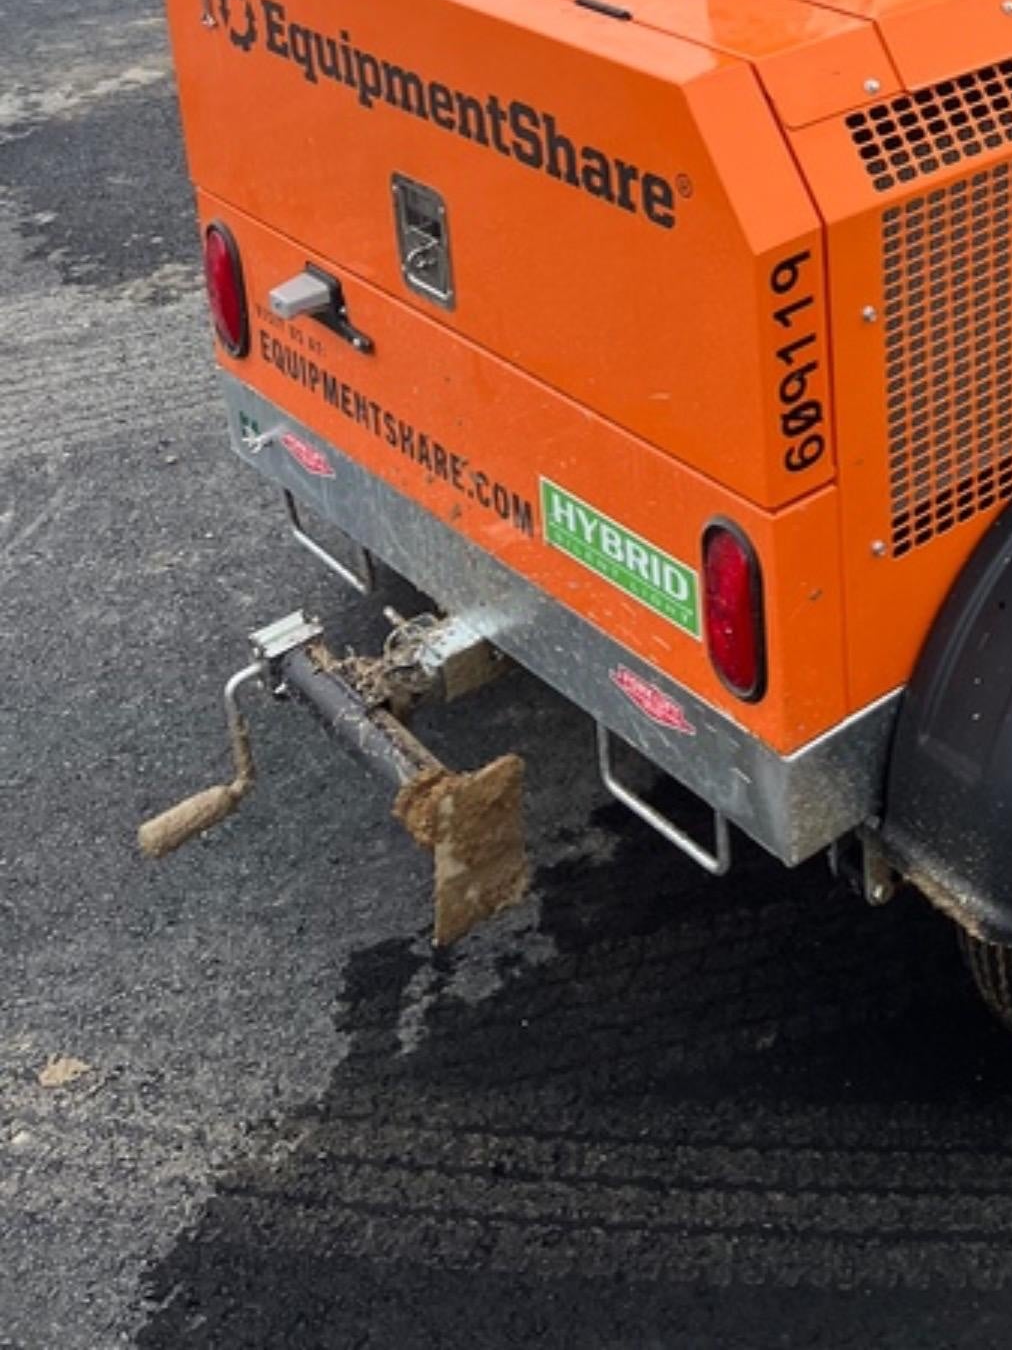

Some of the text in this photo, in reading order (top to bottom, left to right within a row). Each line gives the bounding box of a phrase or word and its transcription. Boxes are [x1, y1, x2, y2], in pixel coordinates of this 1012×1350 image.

[260, 329, 536, 539] EQUIPMENTSHARE.COM
[768, 249, 826, 473] 609119
[551, 492, 690, 601] HYBRID
